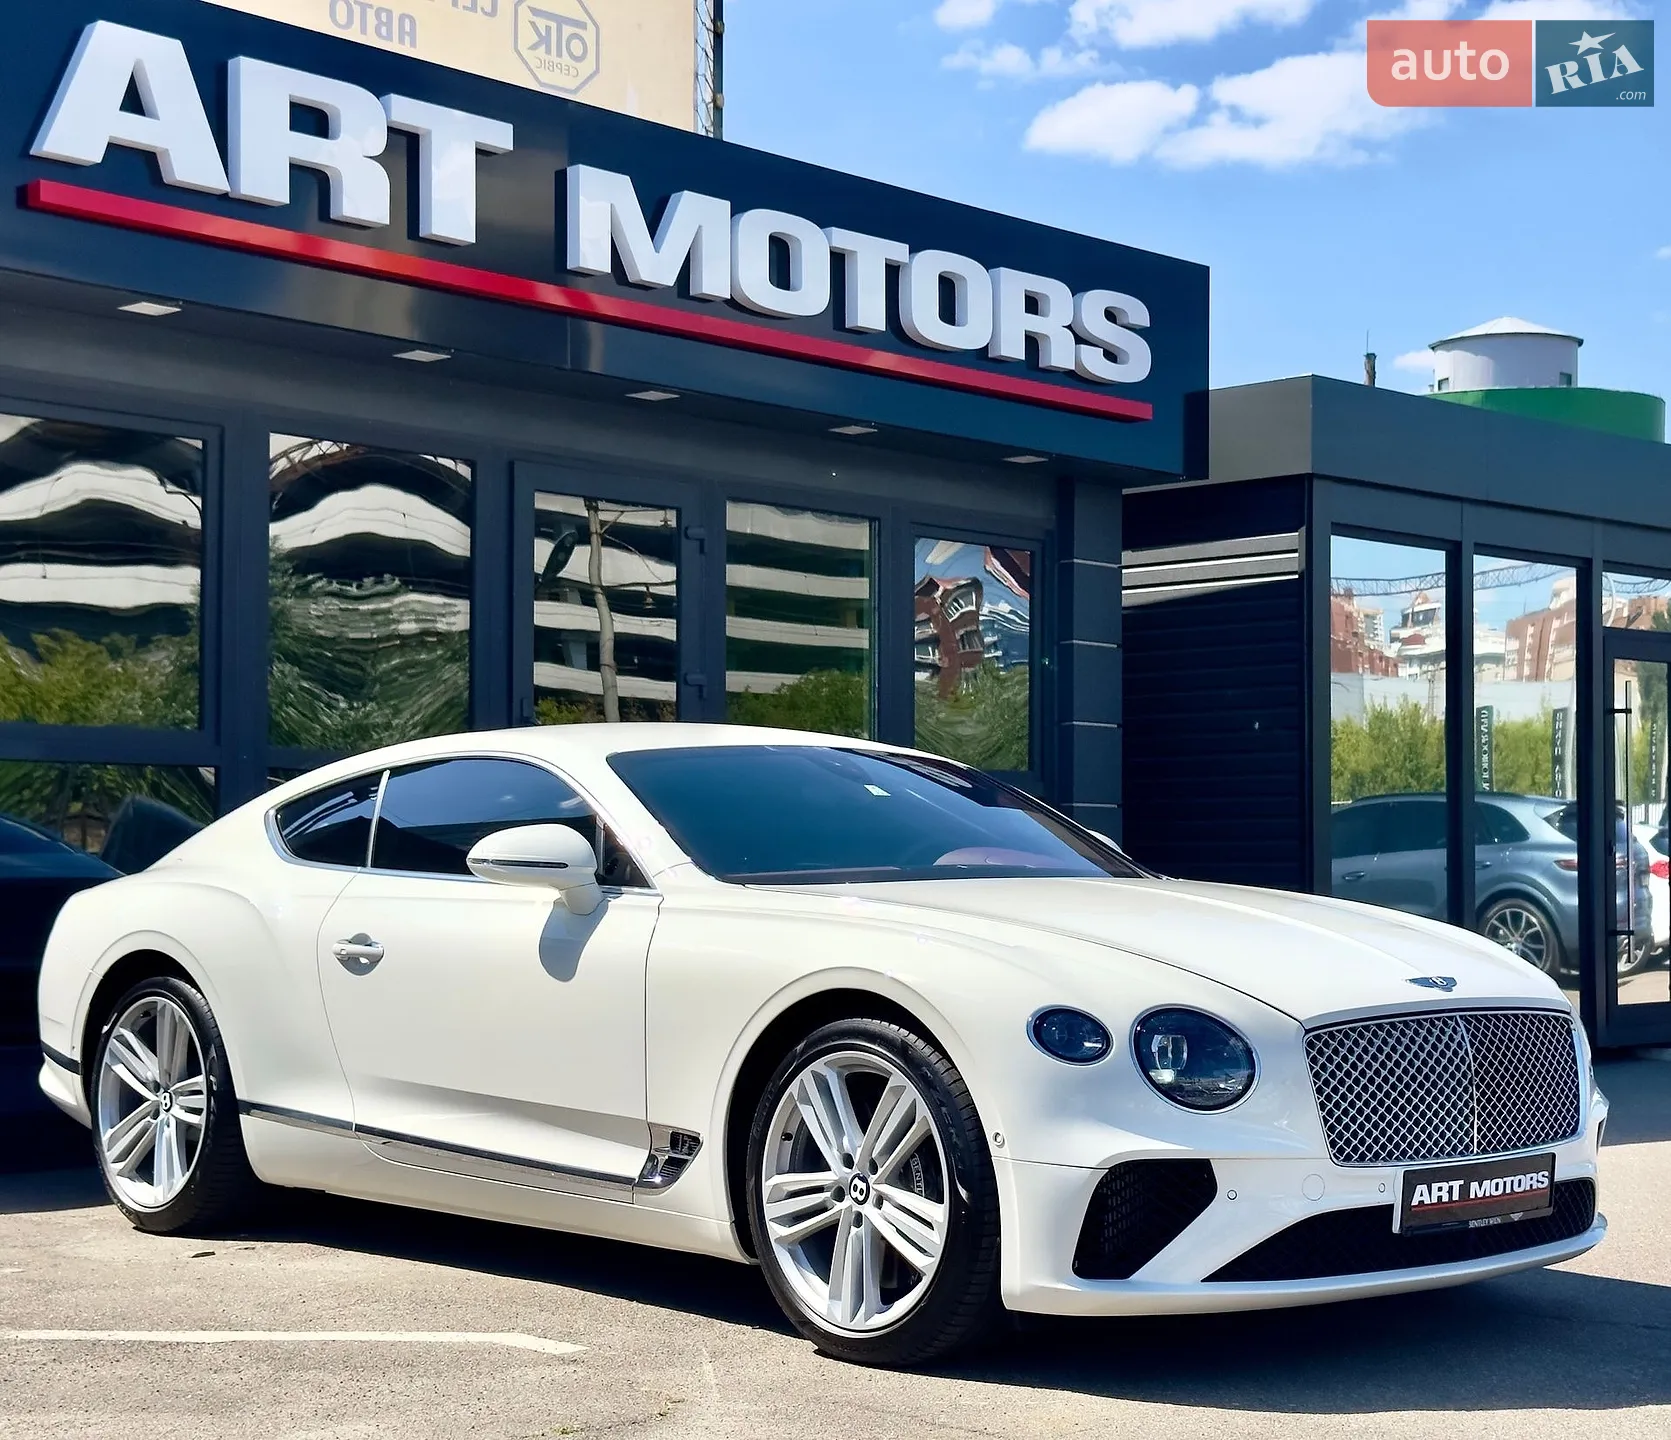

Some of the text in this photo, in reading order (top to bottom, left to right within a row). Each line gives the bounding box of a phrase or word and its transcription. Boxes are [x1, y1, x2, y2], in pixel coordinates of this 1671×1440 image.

[29, 20, 1152, 384] ART MOTORS
[1411, 1170, 1549, 1206] ART MOTORS
